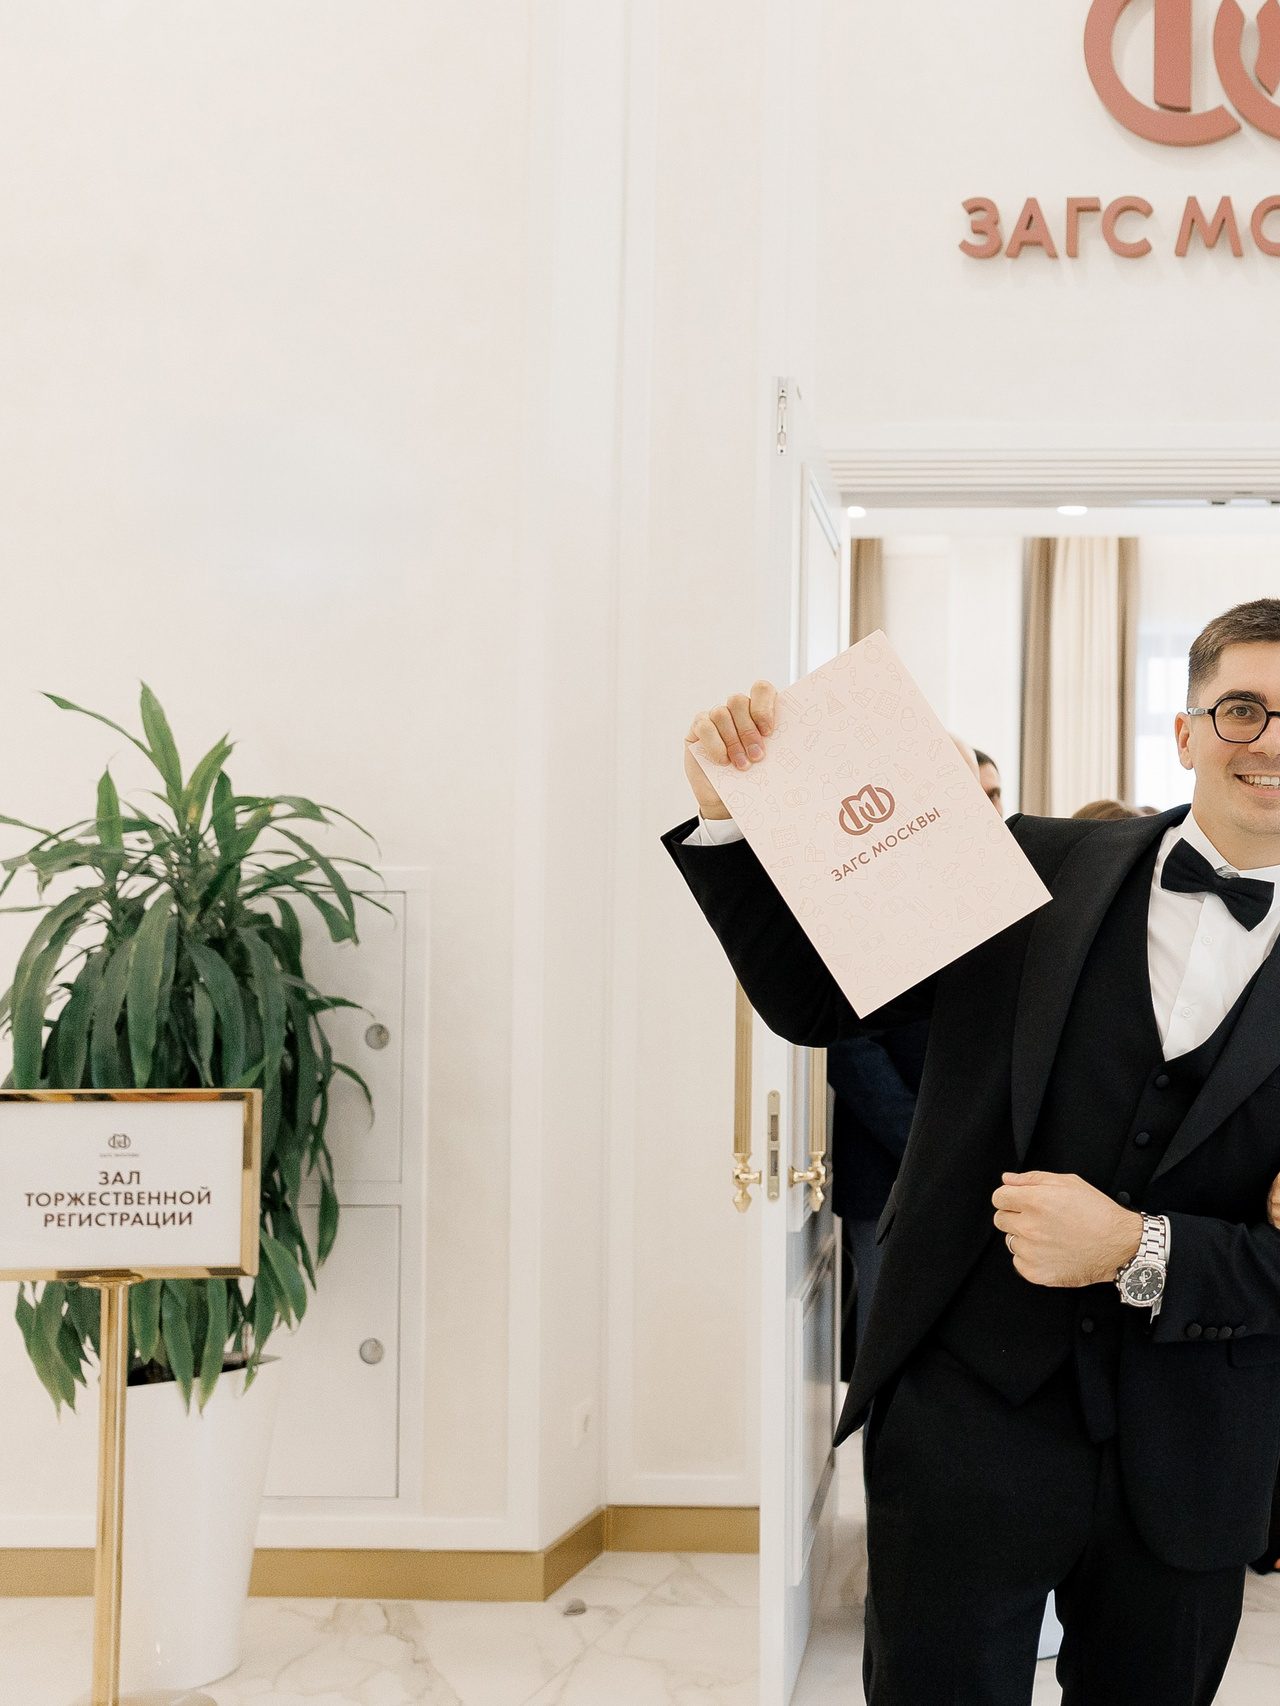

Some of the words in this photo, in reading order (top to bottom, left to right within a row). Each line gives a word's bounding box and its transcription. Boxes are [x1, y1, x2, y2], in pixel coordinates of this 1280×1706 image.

[958, 195, 1154, 258] ЗАГС
[831, 852, 871, 882] ЗАГС
[871, 807, 941, 858] МОСКВЫ
[98, 1171, 141, 1185] ЗАЛ
[25, 1186, 212, 1207] ТОРЖЕСТВЕННОЙ
[43, 1211, 194, 1229] РЕГИСТРАЦИИ
